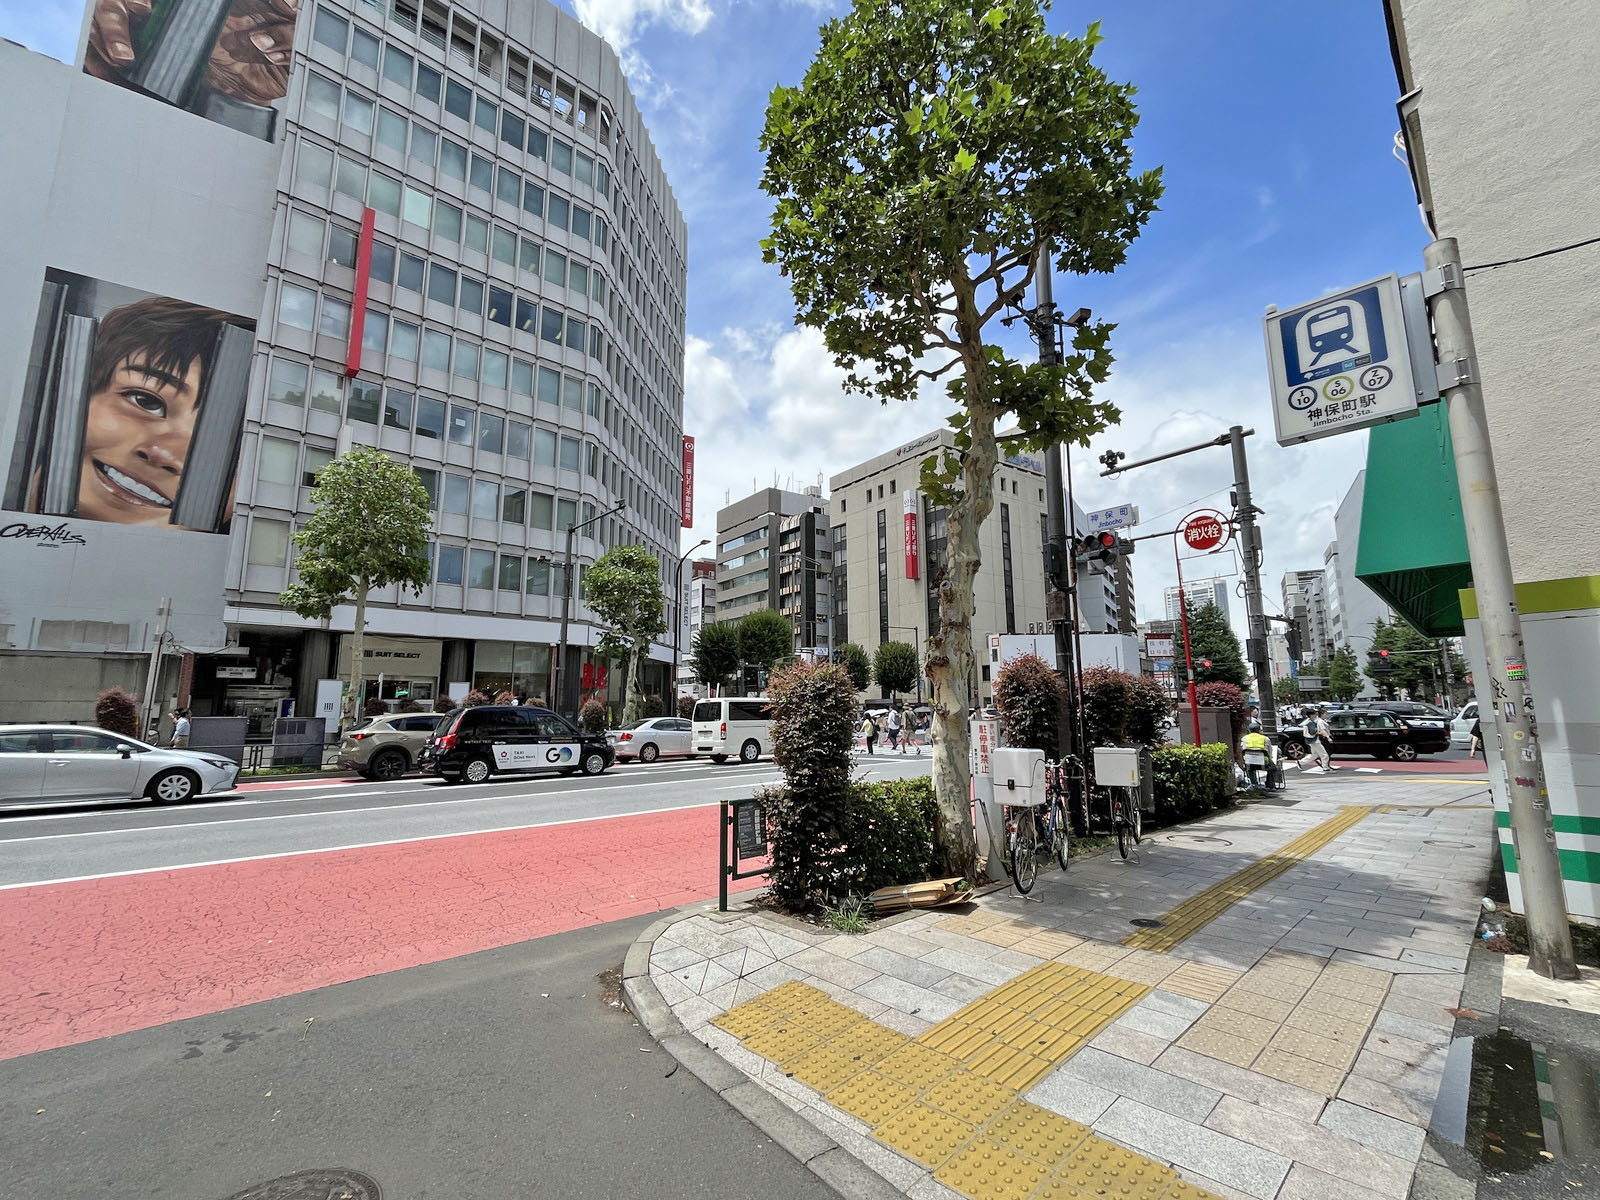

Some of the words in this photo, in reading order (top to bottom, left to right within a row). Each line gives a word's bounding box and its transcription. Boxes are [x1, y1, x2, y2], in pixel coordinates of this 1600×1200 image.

[1368, 376, 1384, 387] 07
[1372, 370, 1379, 378] Z
[1331, 386, 1347, 397] 06
[1334, 380, 1341, 388] S
[1297, 396, 1311, 406] 10
[1306, 393, 1377, 421] 神保町駅
[1312, 413, 1354, 427] Jimbocho
[1356, 409, 1374, 417] Sta.
[1090, 507, 1129, 523] 神保町
[1186, 523, 1220, 542] 消火栓
[545, 746, 573, 763] GO
[979, 724, 989, 774] 駐停車禁止
